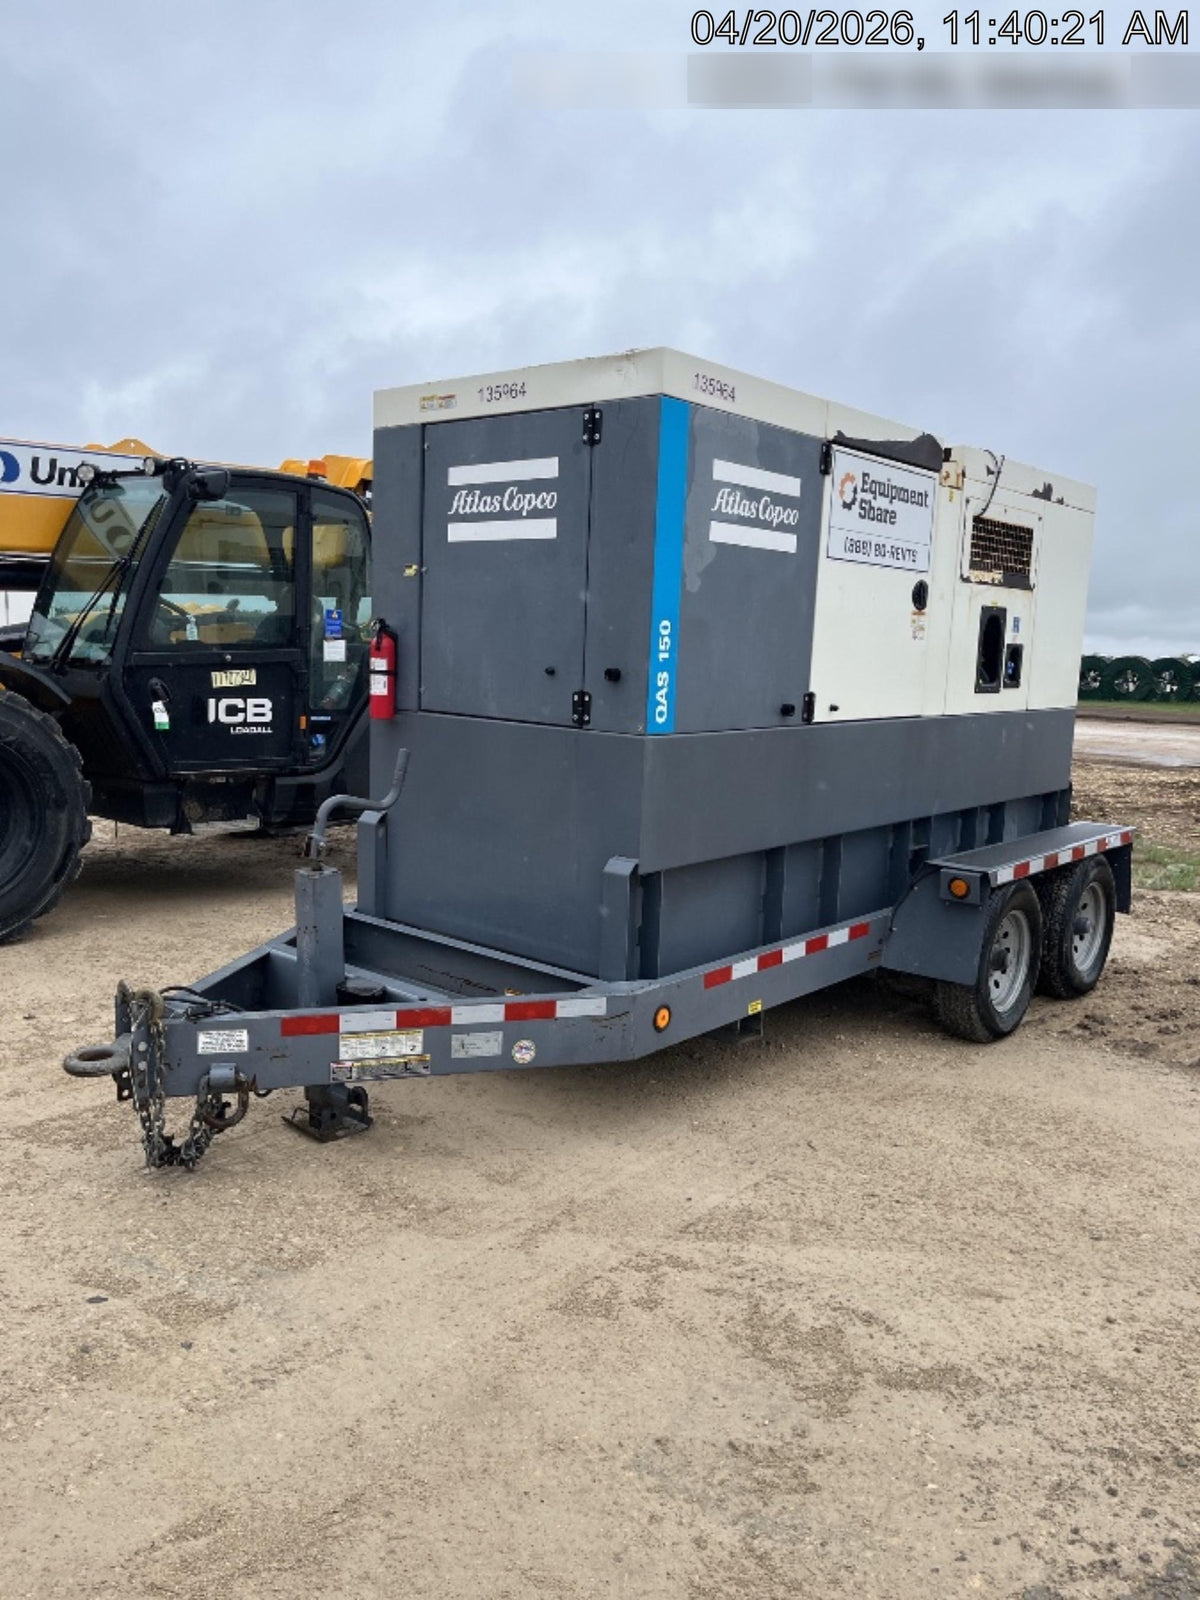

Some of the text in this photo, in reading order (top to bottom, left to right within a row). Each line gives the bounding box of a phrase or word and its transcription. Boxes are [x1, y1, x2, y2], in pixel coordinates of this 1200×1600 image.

[447, 486, 558, 517] Atlas Copco
[711, 488, 799, 527] Atlas Copco
[860, 471, 929, 508] Equipment
[858, 498, 897, 526] Share
[655, 619, 671, 724] QAS 150
